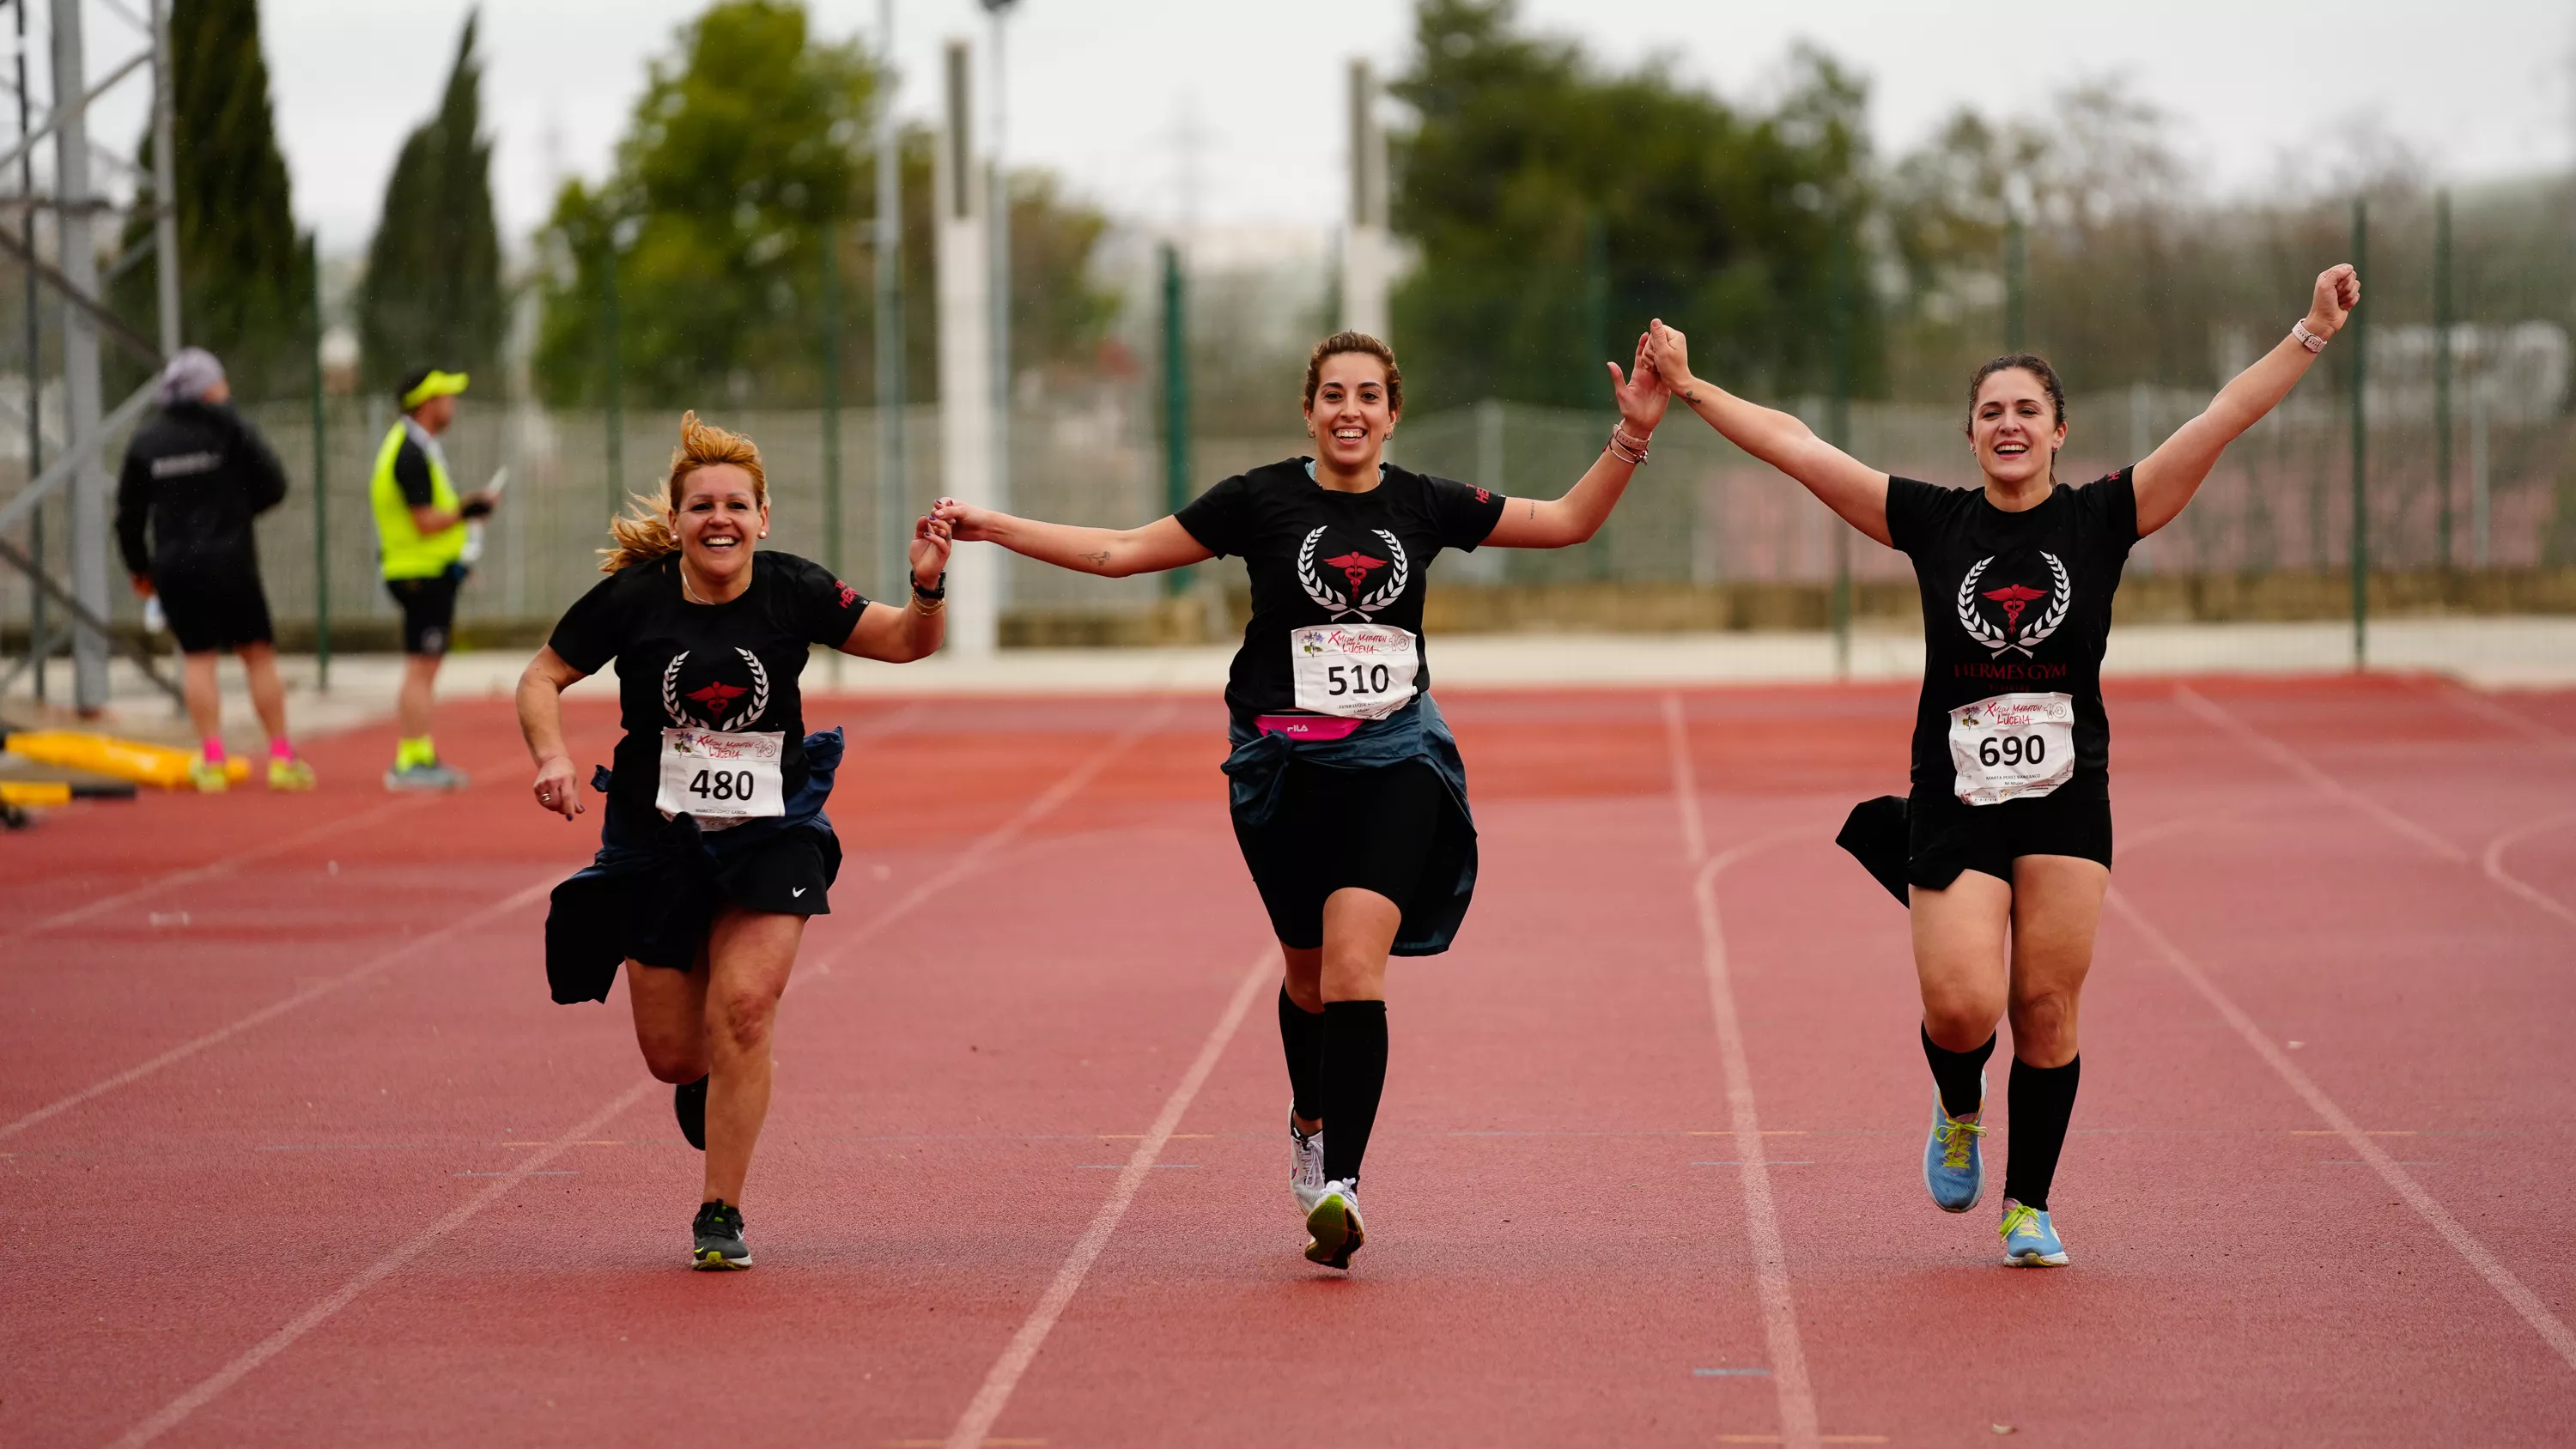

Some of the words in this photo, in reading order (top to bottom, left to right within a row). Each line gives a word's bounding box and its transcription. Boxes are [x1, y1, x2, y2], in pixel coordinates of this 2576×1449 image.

[1342, 644, 1378, 654] LUCENA
[1328, 664, 1390, 696] 510
[1954, 663, 2025, 679] HERMES
[2028, 663, 2067, 680] GYM
[1996, 713, 2032, 725] LUCENA
[709, 747, 744, 760] LUCENA
[1979, 734, 2045, 767] 690
[690, 769, 754, 801] 480
